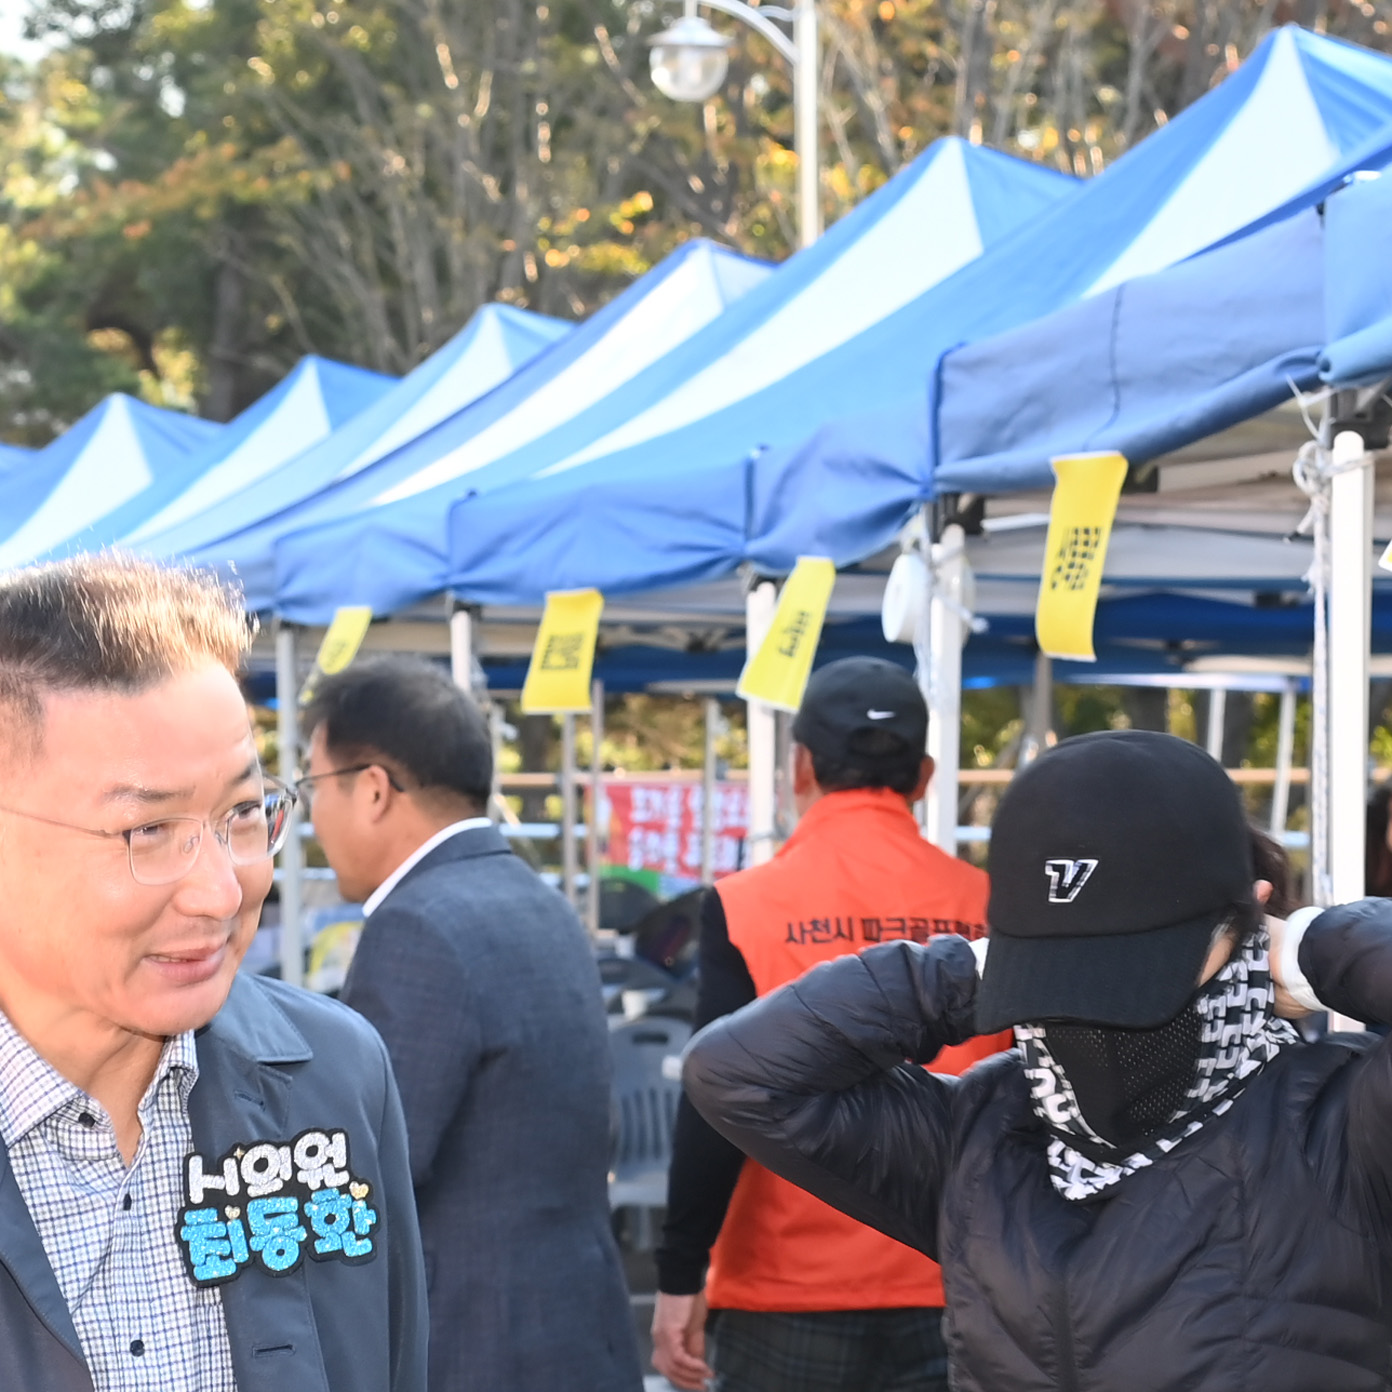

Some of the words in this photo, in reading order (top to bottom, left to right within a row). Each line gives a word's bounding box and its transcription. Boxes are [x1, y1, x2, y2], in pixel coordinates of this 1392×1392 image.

[785, 916, 855, 945] 사천시
[188, 1131, 350, 1205] 시의원
[180, 1187, 377, 1281] 최동환
